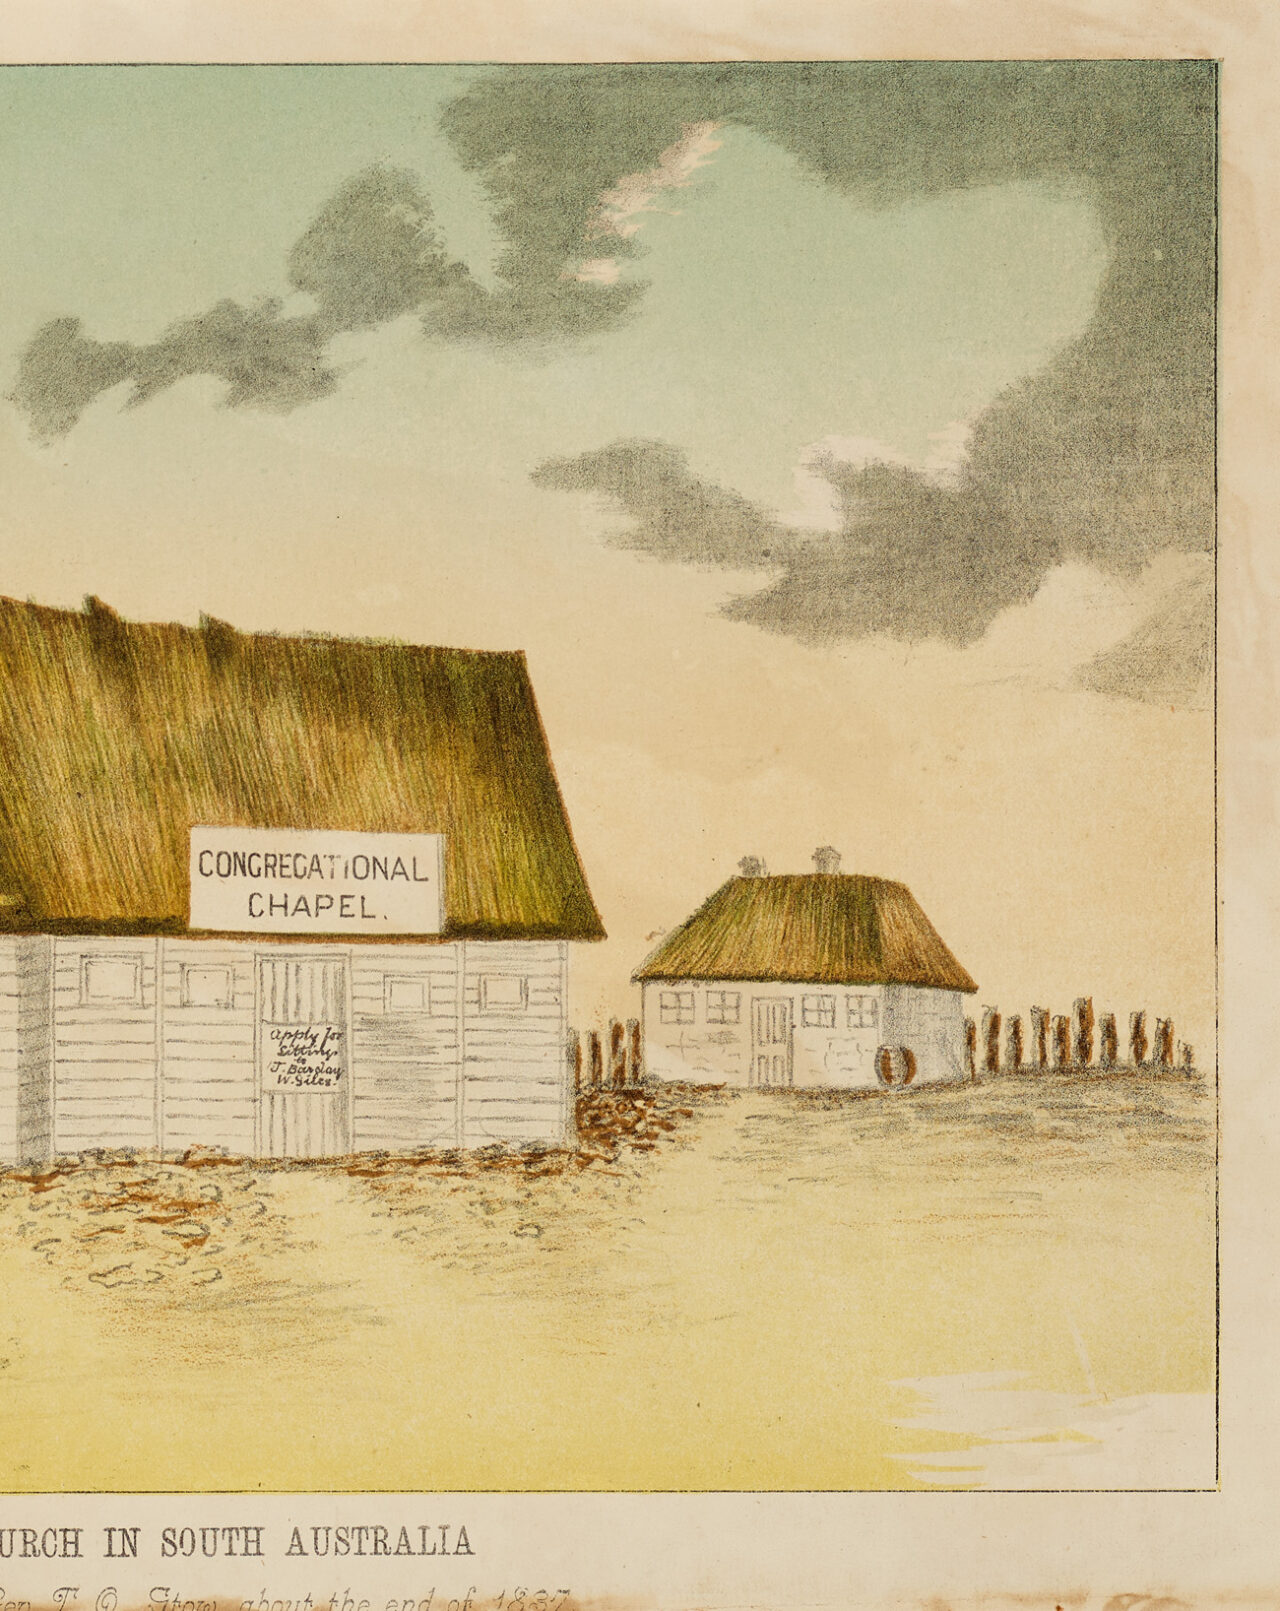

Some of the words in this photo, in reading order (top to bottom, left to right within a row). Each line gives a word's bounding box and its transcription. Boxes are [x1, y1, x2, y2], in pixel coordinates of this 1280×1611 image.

[198, 849, 430, 883] CONGREGATIONAL
[248, 891, 388, 921] CHAPEL.
[102, 1526, 142, 1559] IN
[160, 1525, 266, 1558] SOUTH
[284, 1523, 477, 1557] AUSTRALIA
